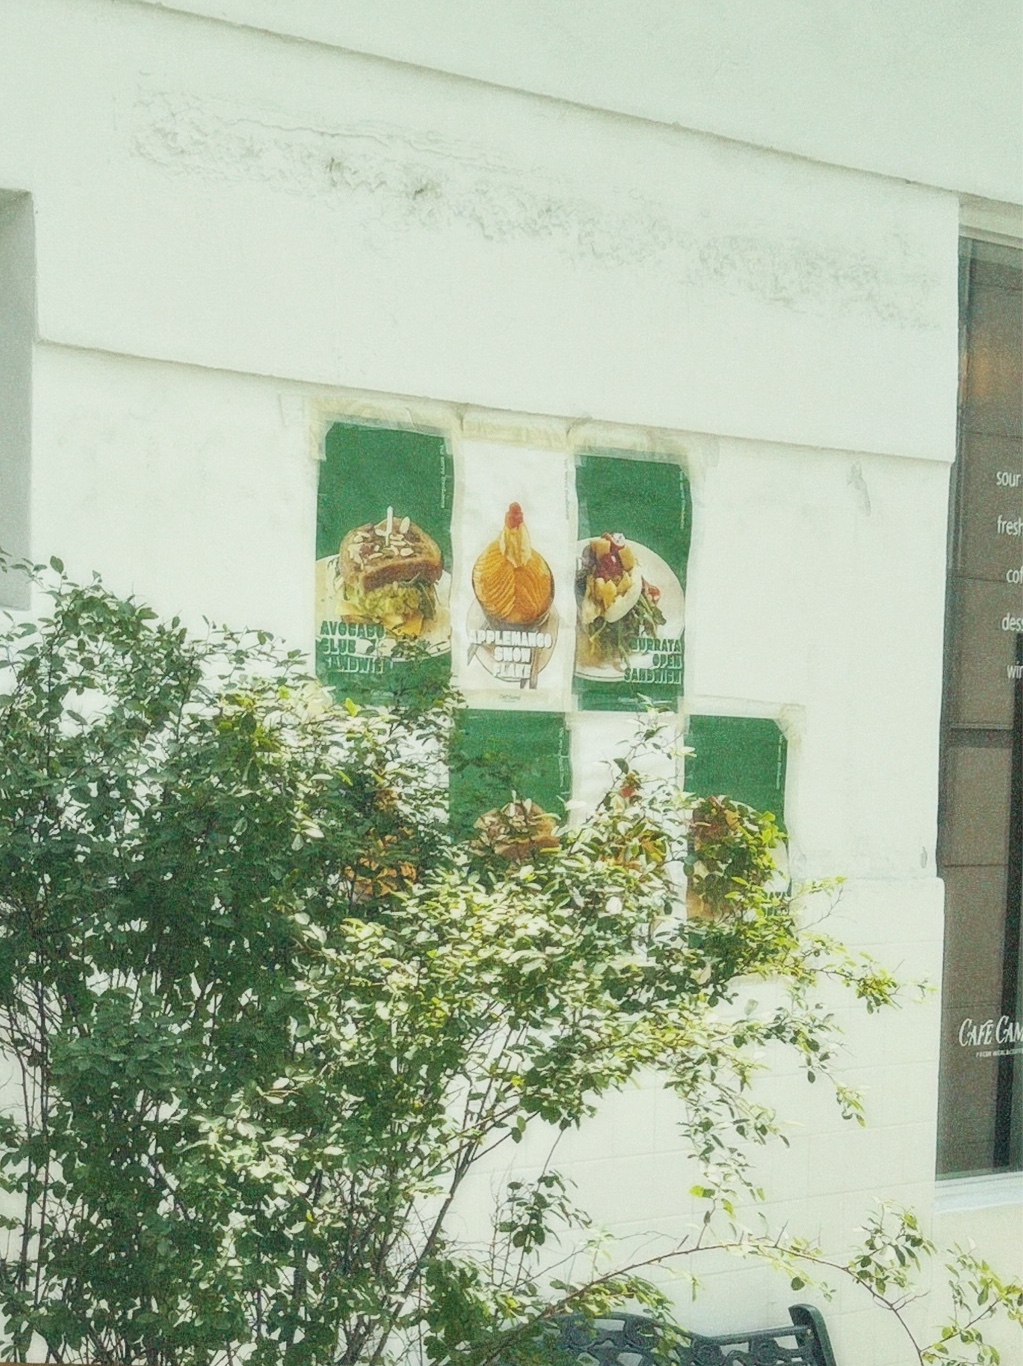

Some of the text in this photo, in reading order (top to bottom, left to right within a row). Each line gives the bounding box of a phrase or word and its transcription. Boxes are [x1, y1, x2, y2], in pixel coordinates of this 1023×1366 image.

[996, 471, 1021, 487] sour
[470, 629, 553, 649] APPLEMANGO
[494, 646, 532, 664] SNOW
[652, 653, 683, 669] OPEN
